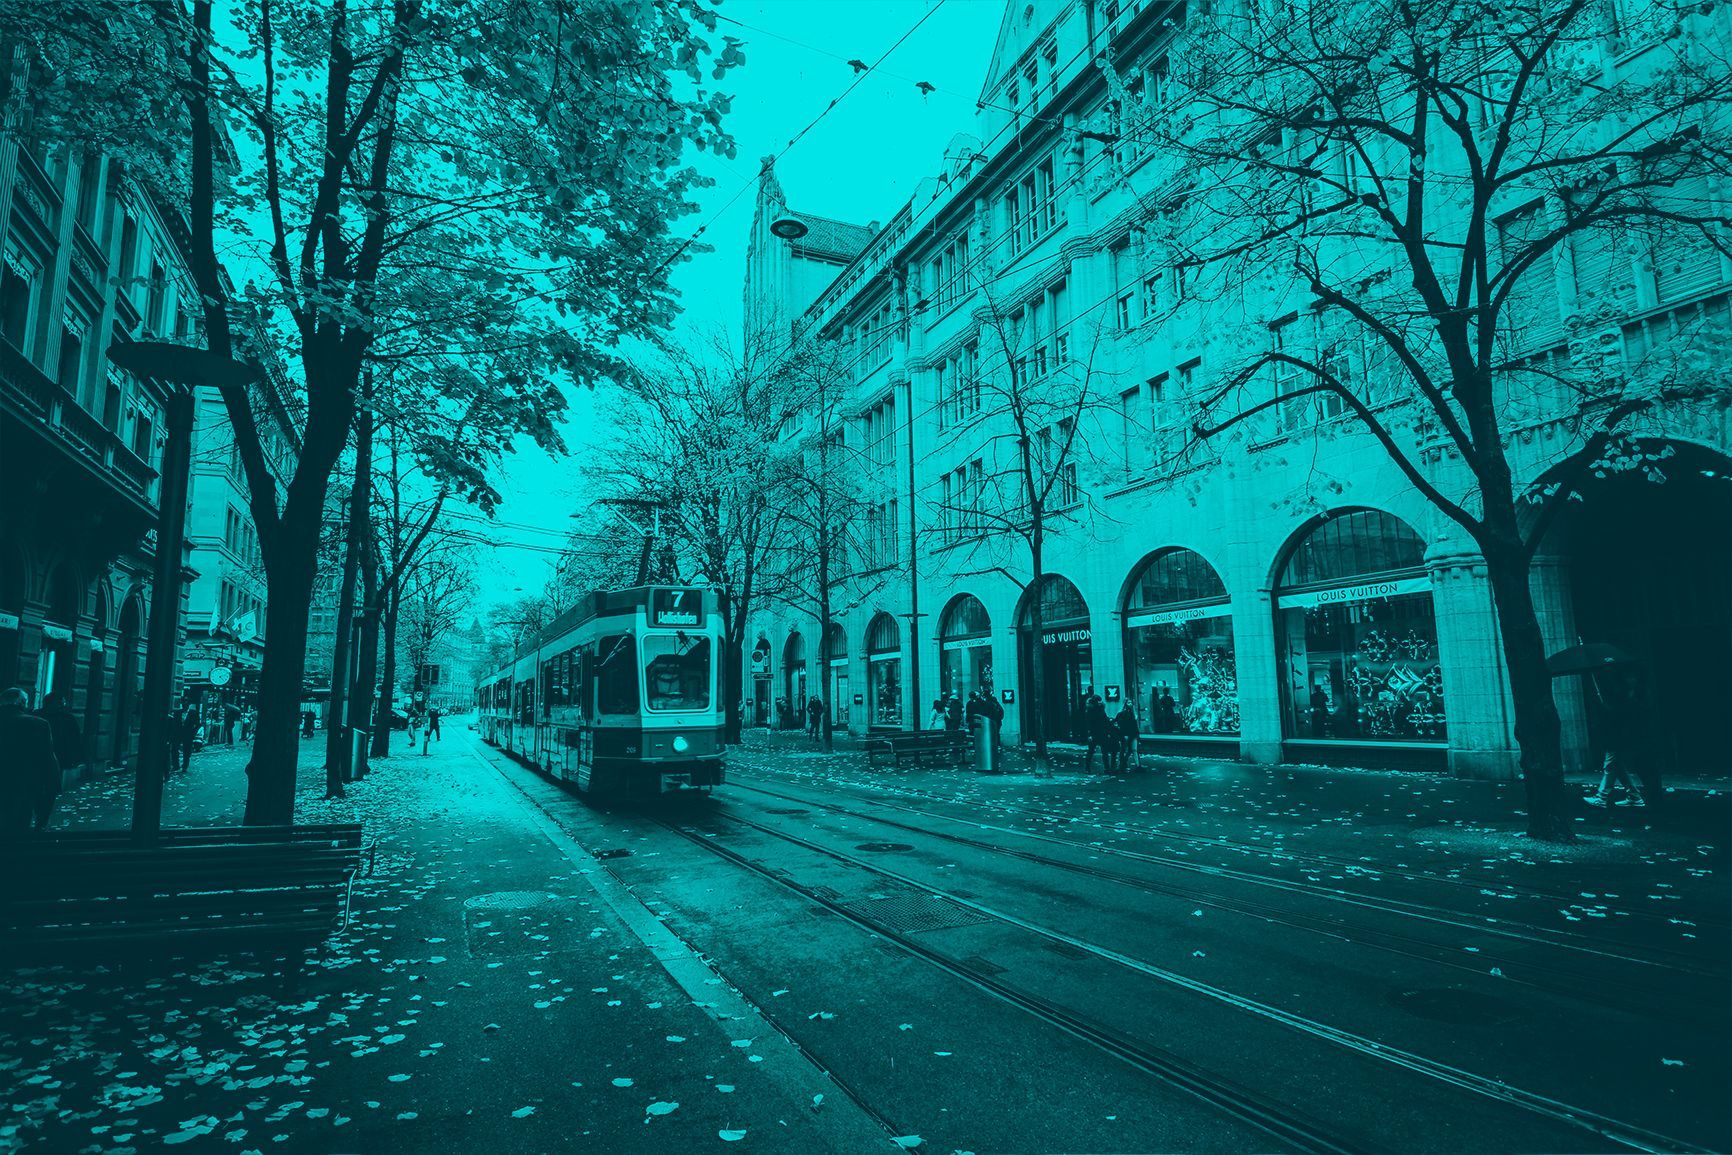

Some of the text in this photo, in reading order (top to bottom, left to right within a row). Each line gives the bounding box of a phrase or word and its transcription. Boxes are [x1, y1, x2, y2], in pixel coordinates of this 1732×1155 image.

[671, 590, 685, 608] 7
[1316, 583, 1398, 602] LOUIS VUITTON
[1152, 609, 1205, 623] LOUIS VUITTON
[1042, 629, 1092, 645] UIS VUITTON
